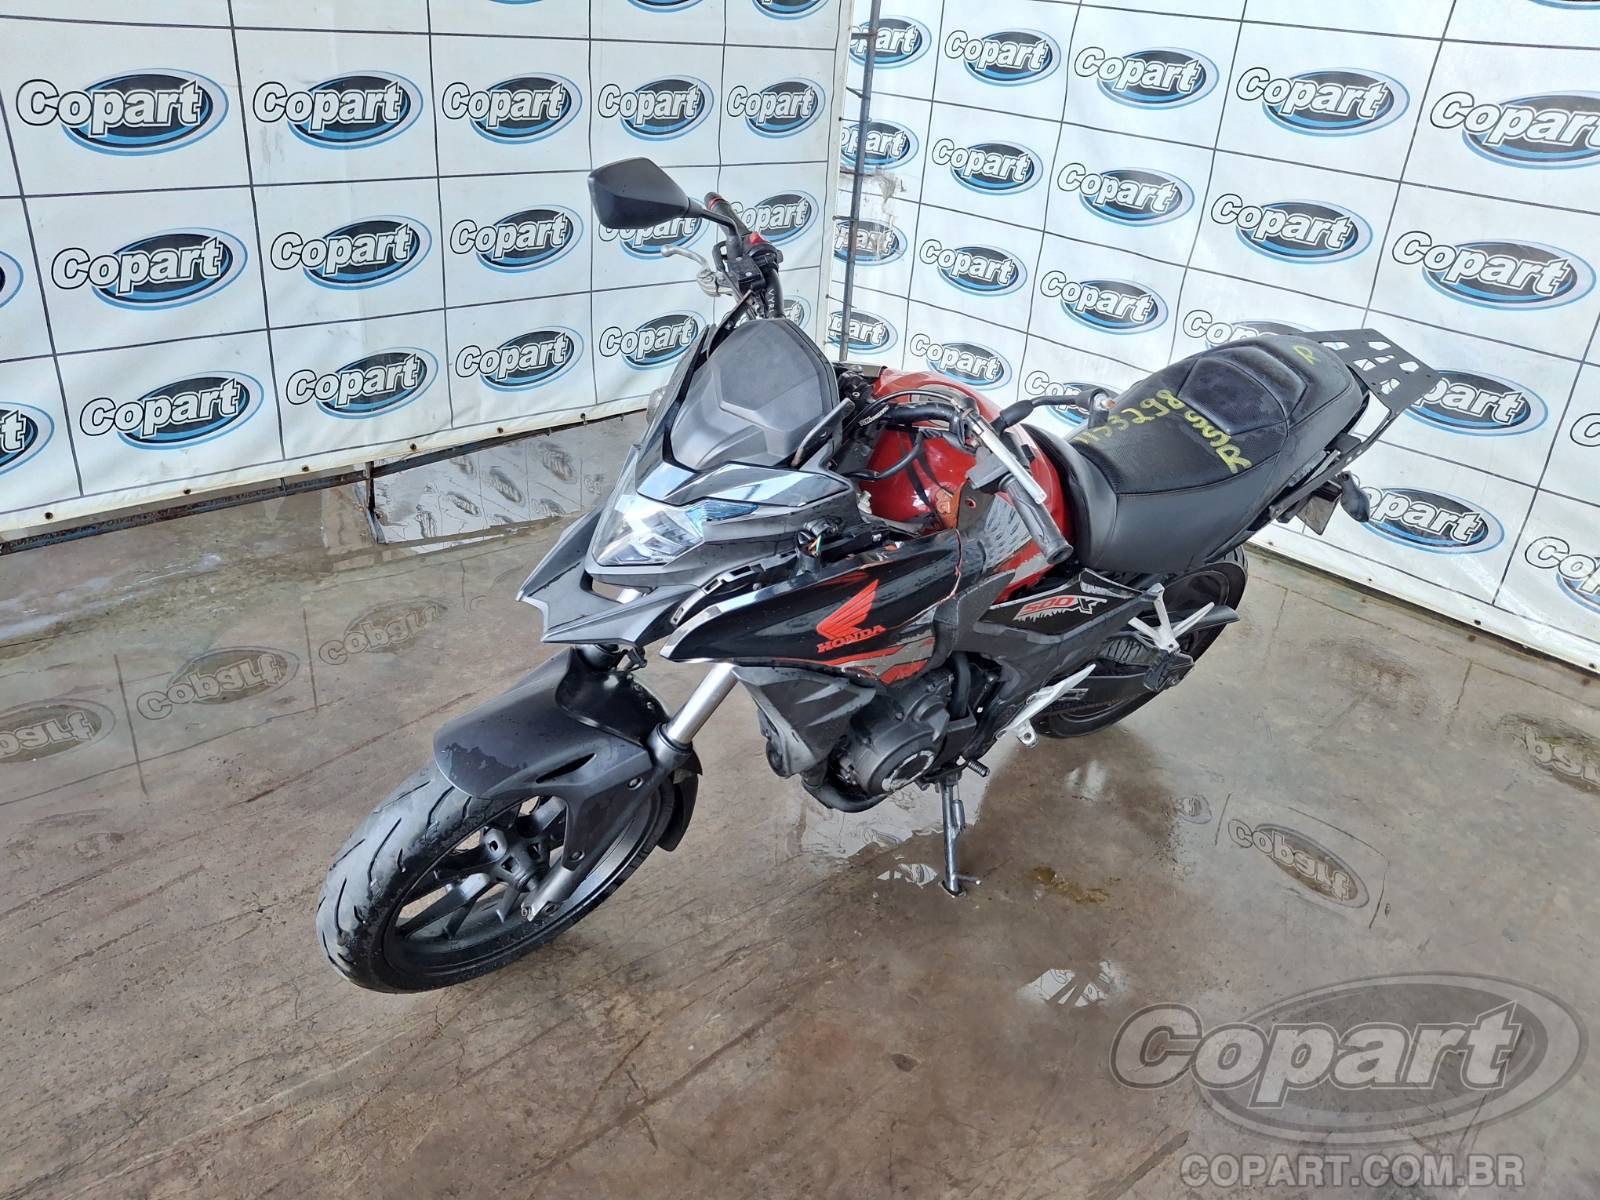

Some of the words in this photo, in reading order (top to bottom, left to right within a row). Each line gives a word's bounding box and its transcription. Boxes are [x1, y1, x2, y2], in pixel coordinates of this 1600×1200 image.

[945, 30, 1048, 72] Copart
[1074, 47, 1203, 93] Copart
[16, 79, 203, 138] Copart
[253, 81, 402, 133] Copart
[442, 82, 567, 130] Copart
[598, 83, 700, 127] Copart
[727, 84, 815, 125] Copart
[1236, 67, 1387, 119] Copart
[932, 138, 1031, 182] Copart
[1057, 162, 1178, 215] Copart
[451, 215, 569, 258] Copart
[1211, 193, 1352, 249] Copart
[51, 236, 222, 296] Copart
[270, 224, 413, 277] Copart
[919, 239, 1016, 286] Copart
[1392, 231, 1570, 295] Copart
[1040, 270, 1154, 323] Copart
[455, 333, 571, 381] Copart
[599, 316, 694, 361] Copart
[909, 333, 1001, 381] Copart
[286, 353, 422, 410] Copart
[1415, 377, 1524, 424] part
[80, 378, 242, 438] Copart
[816, 625, 887, 653] HONDA
